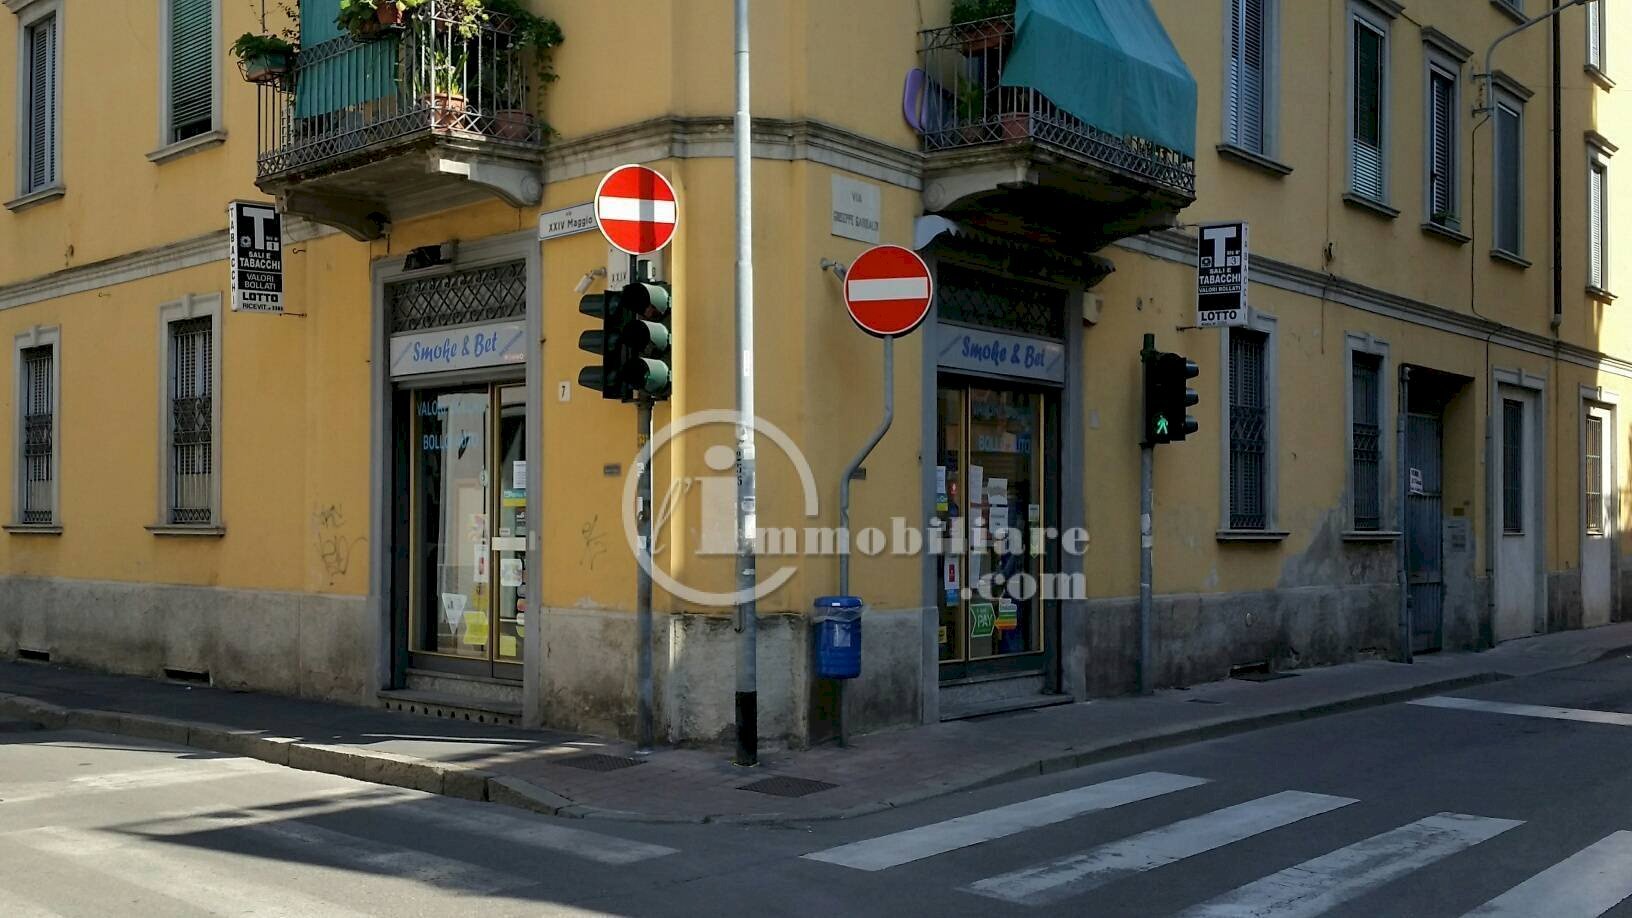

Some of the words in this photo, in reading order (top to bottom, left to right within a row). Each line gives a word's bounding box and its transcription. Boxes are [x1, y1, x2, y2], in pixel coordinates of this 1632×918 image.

[242, 206, 275, 250] T
[548, 220, 565, 233] XXIV
[567, 216, 593, 228] Maggio
[1203, 226, 1237, 268] T
[248, 250, 265, 259] SALI
[239, 257, 281, 270] TABACCHI
[246, 273, 274, 283] VALORI
[1199, 273, 1241, 285] TABACCHI
[244, 280, 276, 291] BOLLATI
[1218, 285, 1241, 293] BOLLATI
[242, 291, 279, 303] LOTTO
[1200, 310, 1237, 322] LOTTO
[413, 339, 457, 363] Smoke
[461, 335, 470, 357] &
[473, 331, 497, 358] Bet
[961, 335, 1007, 367] Smoke
[1010, 343, 1021, 365] &
[1024, 344, 1046, 369] Bet
[977, 613, 993, 629] PAY
